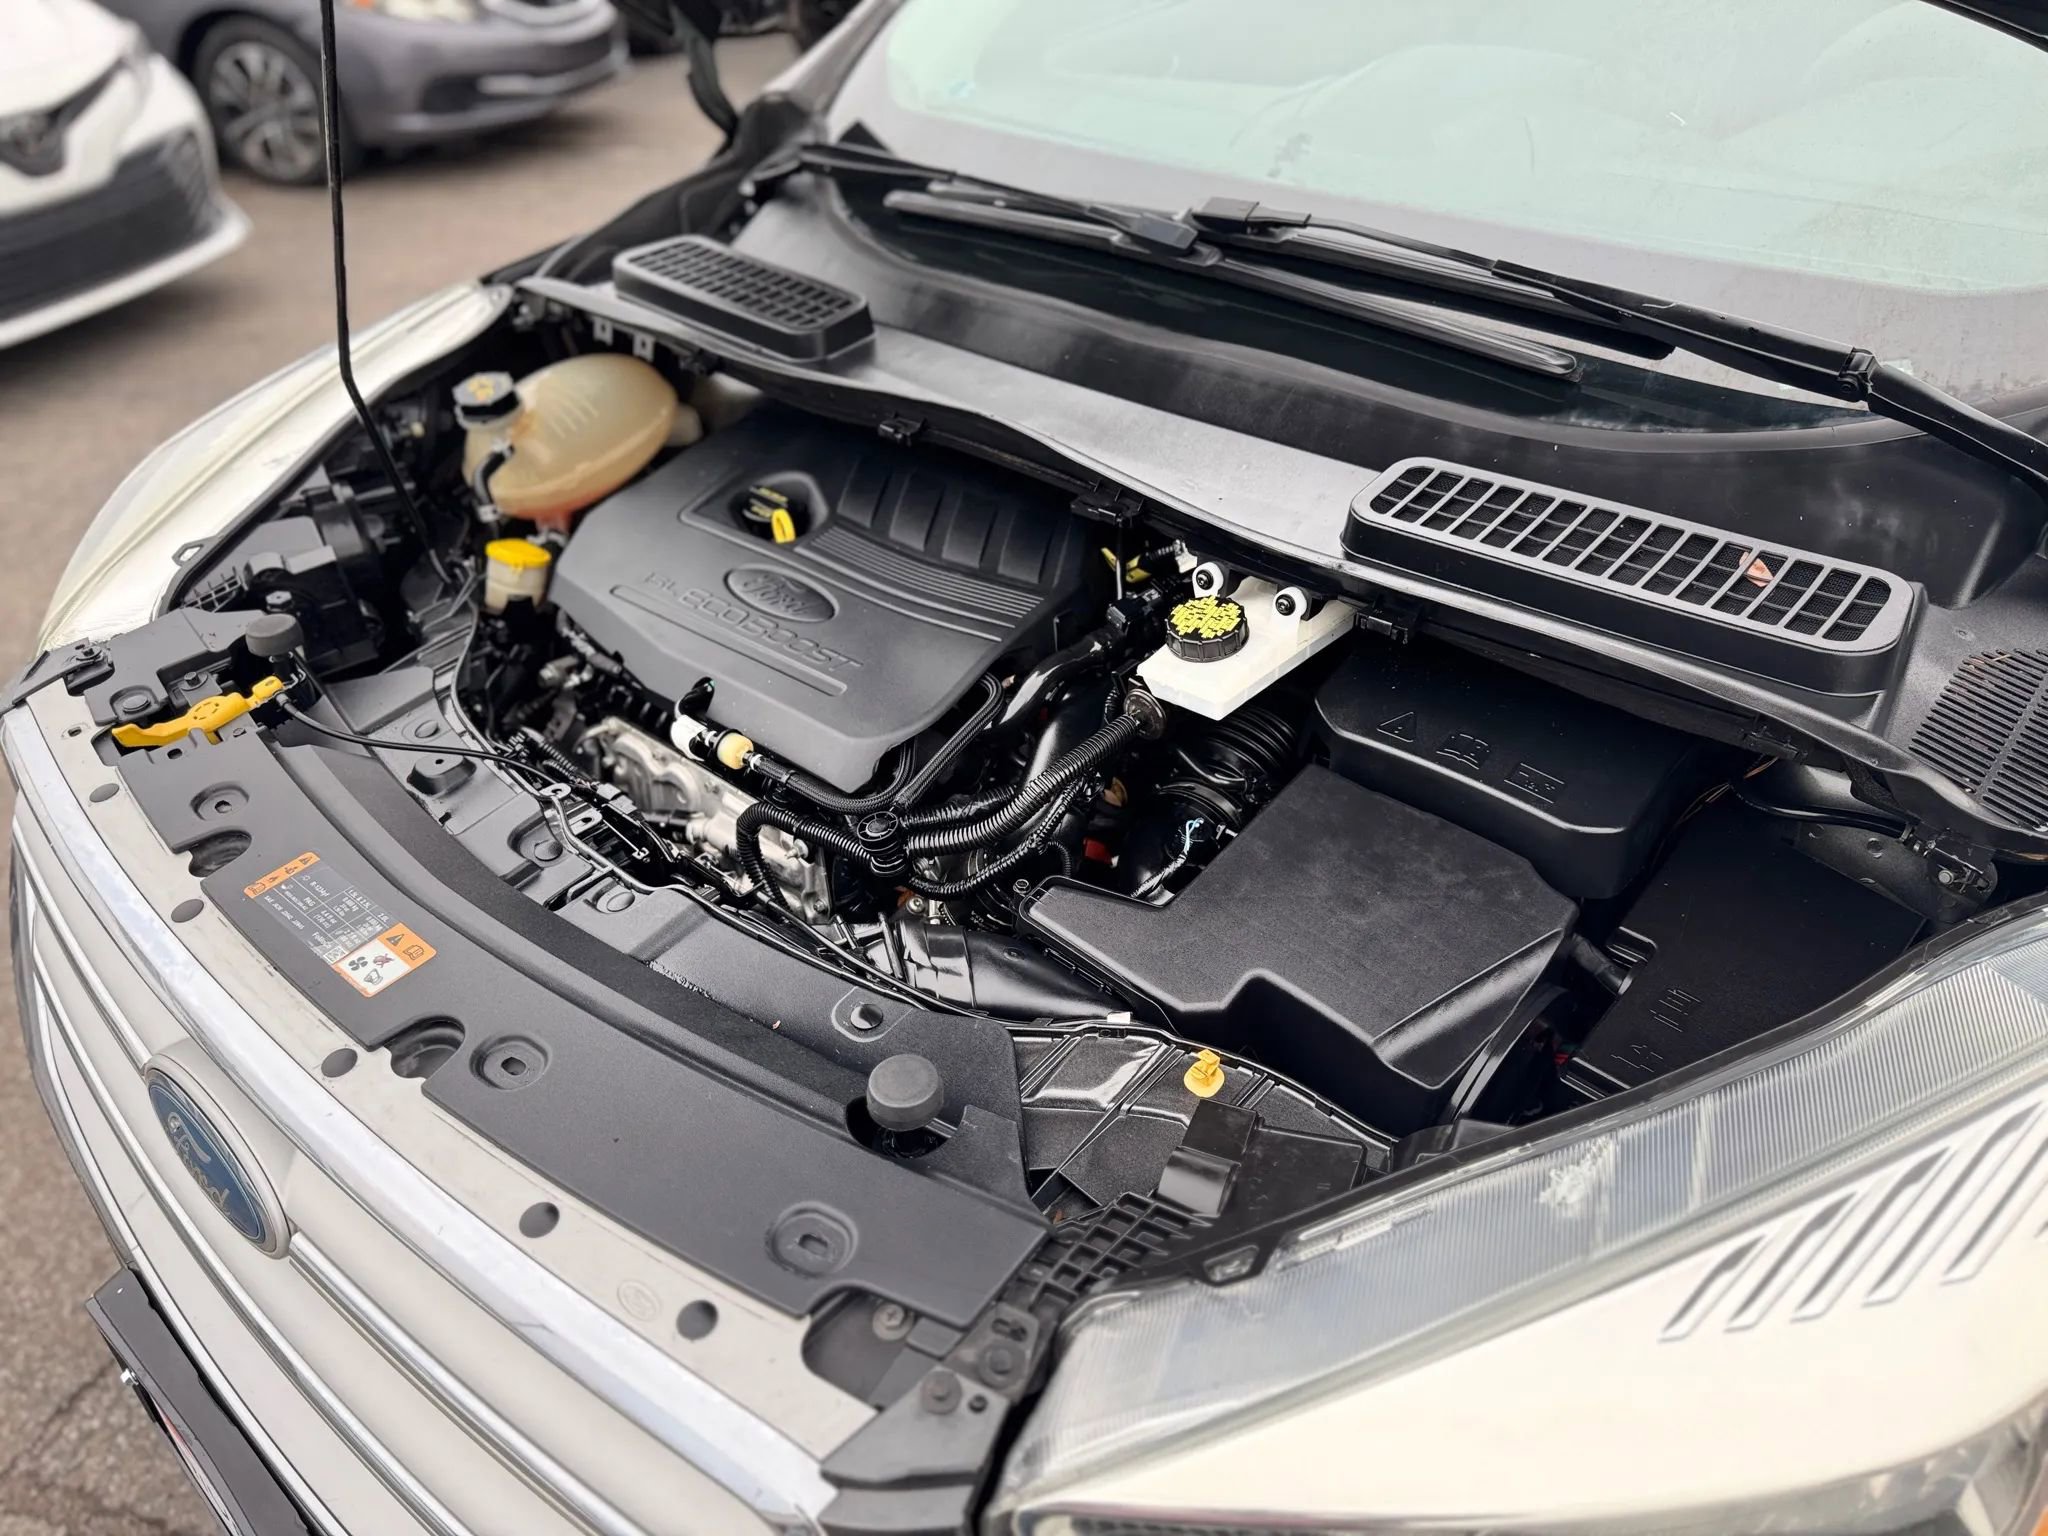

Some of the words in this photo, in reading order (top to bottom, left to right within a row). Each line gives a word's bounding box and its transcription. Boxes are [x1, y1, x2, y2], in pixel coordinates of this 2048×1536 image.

[680, 588, 863, 672] ECOBOOST
[742, 576, 810, 615] Ford
[168, 1112, 231, 1216] Ford
